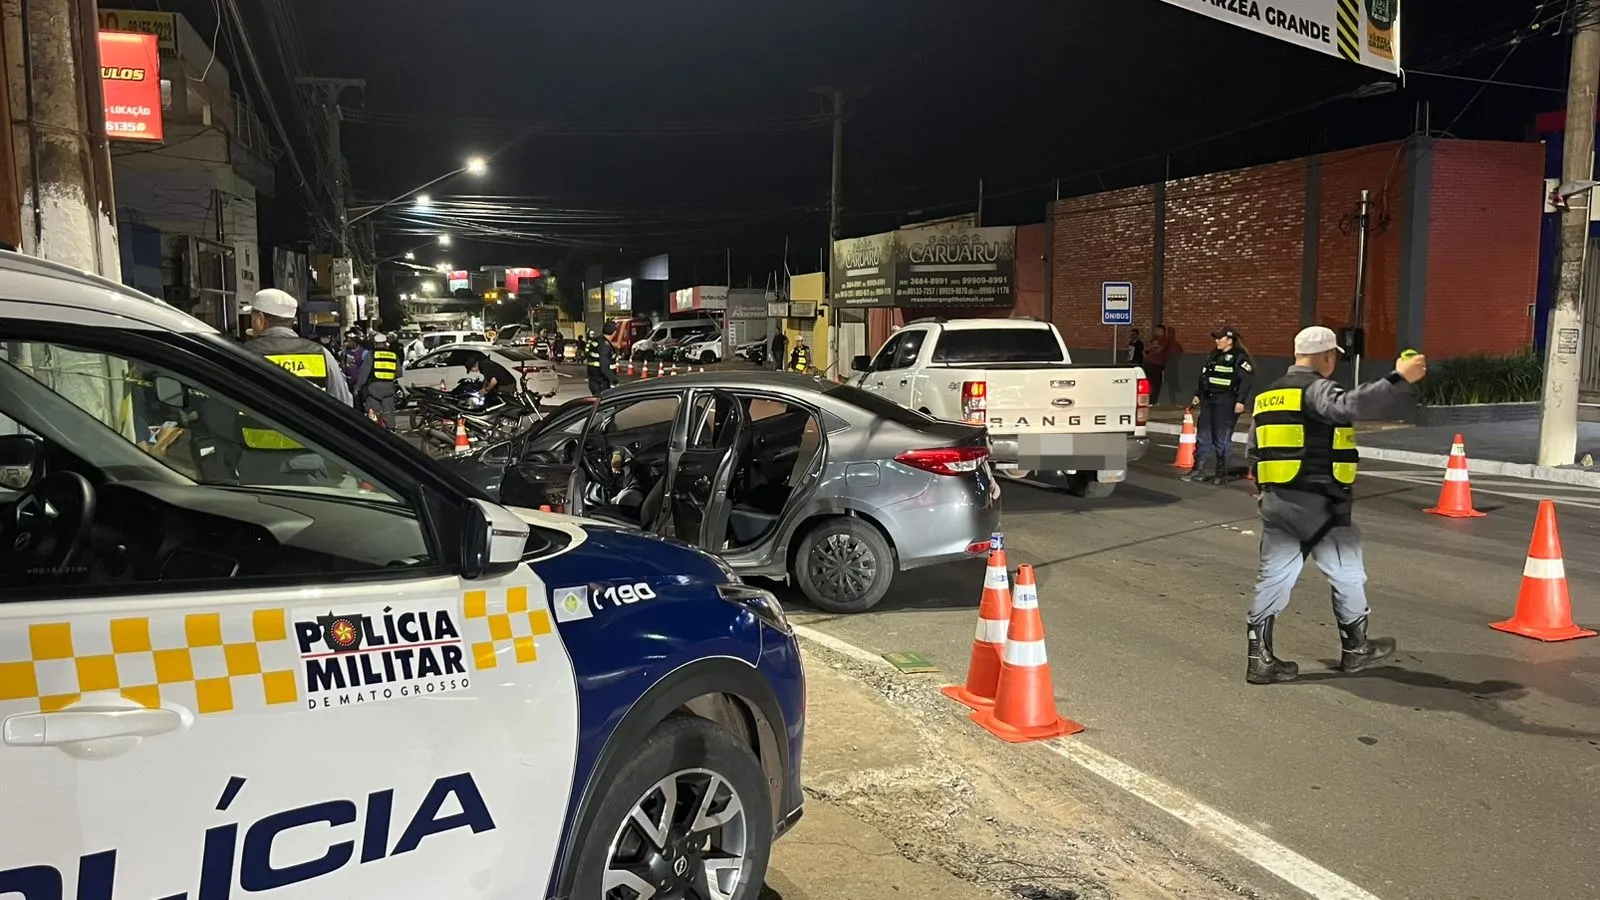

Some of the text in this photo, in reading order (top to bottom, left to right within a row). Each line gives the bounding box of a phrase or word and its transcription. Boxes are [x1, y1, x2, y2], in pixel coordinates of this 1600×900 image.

[1265, 6, 1331, 44] GRANDE
[110, 105, 151, 118] LOCAÇÃO
[909, 241, 999, 264] CARUARU
[1104, 311, 1129, 320] ÔNIBUS
[989, 414, 1132, 428] RANGER
[604, 582, 657, 607] 190
[306, 645, 466, 693] MILITAR
[308, 678, 470, 710] DE MATO GROSSO
[0, 771, 497, 900] LÍCIA
